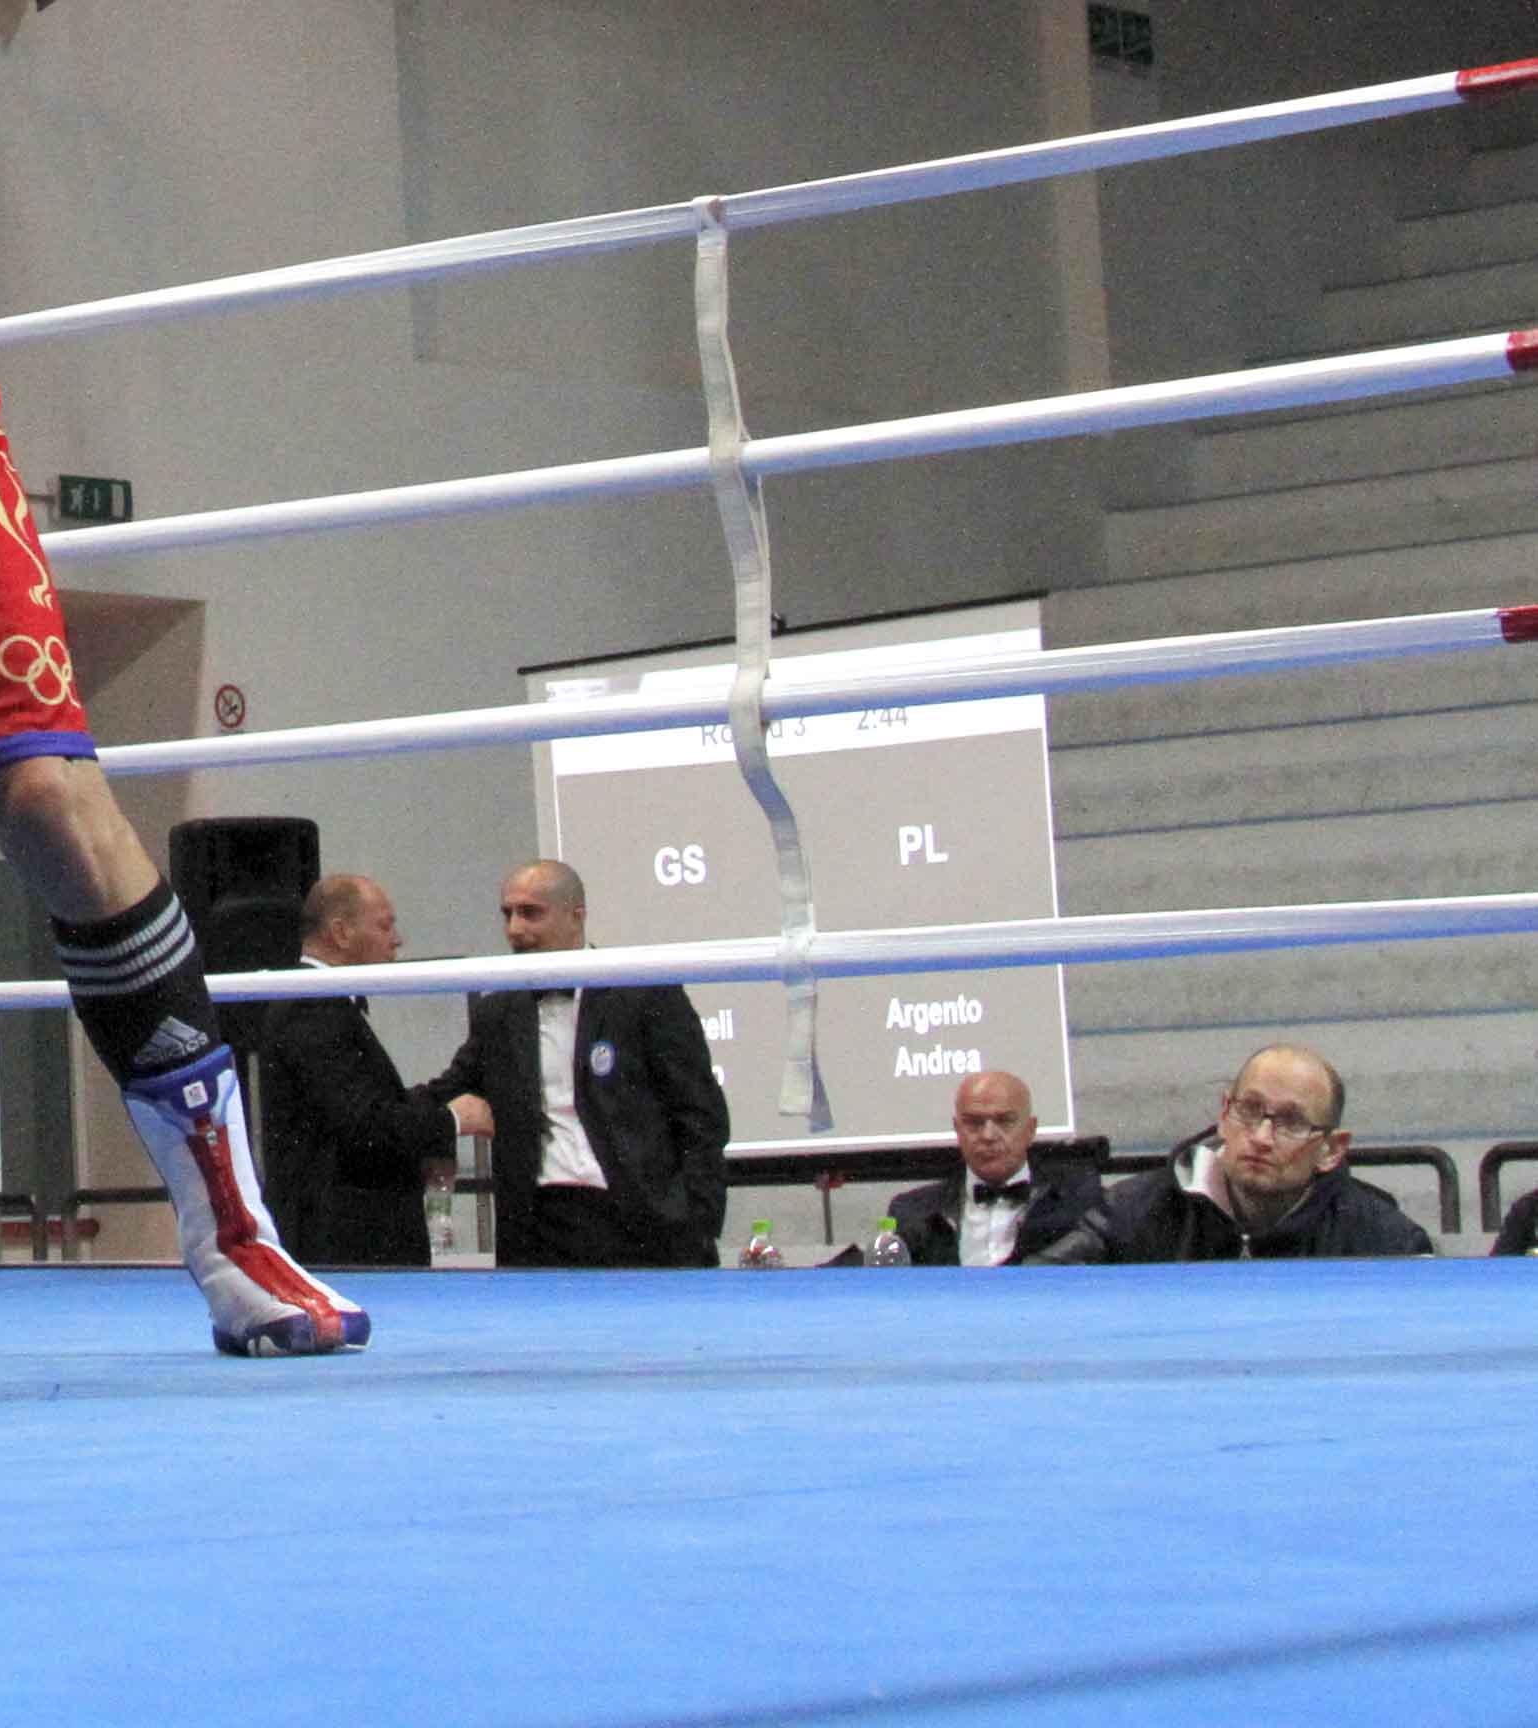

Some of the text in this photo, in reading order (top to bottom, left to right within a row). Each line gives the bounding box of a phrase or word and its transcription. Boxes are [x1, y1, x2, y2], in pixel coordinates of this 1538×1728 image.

[654, 843, 708, 886] GS
[898, 823, 950, 866] PL
[885, 993, 982, 1034] Argento
[893, 1043, 982, 1078] Andrea
